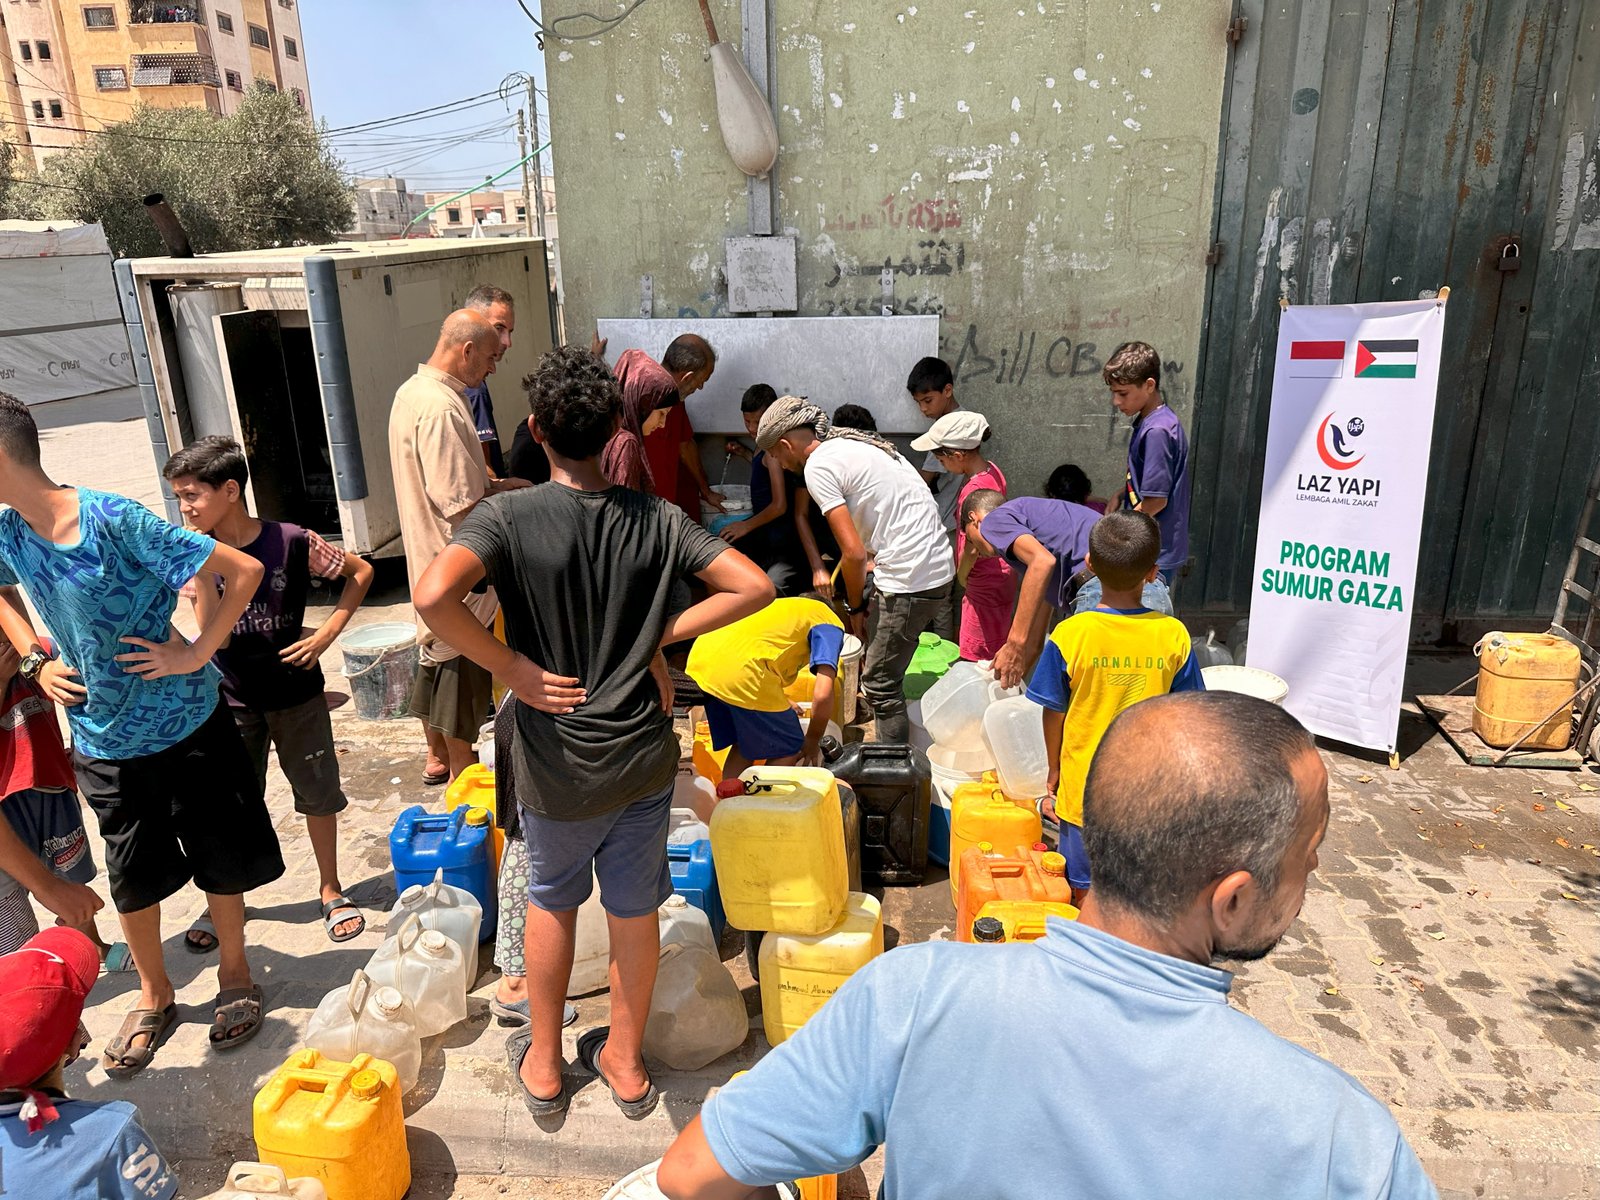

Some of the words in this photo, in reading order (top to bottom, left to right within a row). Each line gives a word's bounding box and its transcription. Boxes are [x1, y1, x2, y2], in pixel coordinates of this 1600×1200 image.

[1296, 493, 1331, 504] LEMBAGA
[1331, 497, 1351, 506] AMIL
[1352, 498, 1379, 508] ZAKAT
[1297, 473, 1332, 493] LAZ
[1337, 476, 1381, 497] YAPI
[1279, 540, 1391, 578] PROGRAM
[1260, 568, 1334, 602] SUMUR
[1337, 578, 1404, 612] GAZA
[1092, 656, 1165, 670] RONALDO
[1106, 673, 1147, 718] 7
